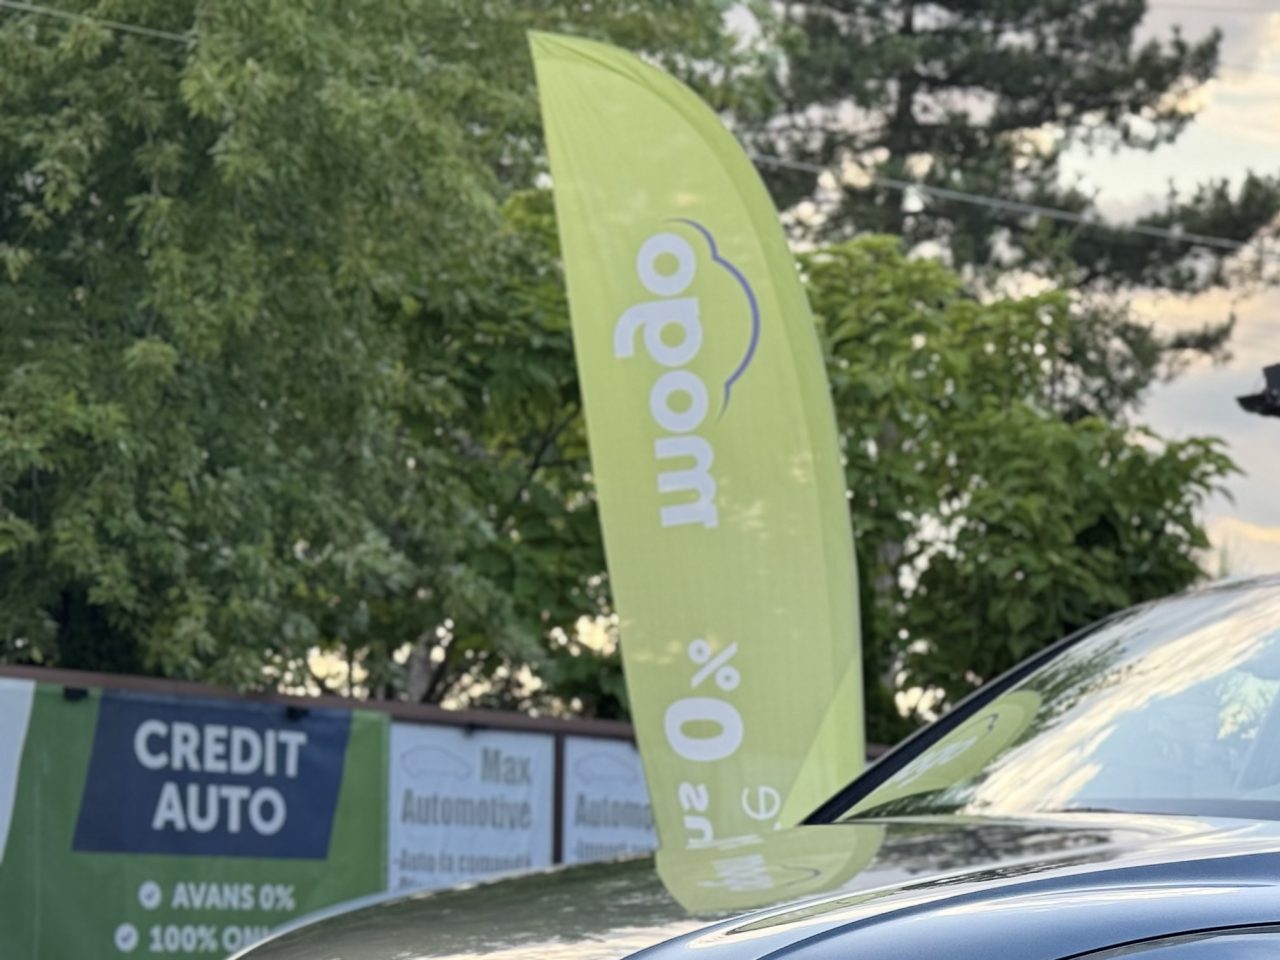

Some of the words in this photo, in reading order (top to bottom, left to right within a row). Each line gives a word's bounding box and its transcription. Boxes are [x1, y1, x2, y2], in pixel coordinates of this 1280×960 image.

[133, 719, 308, 778] CREDIT
[480, 747, 532, 785] Max
[151, 782, 287, 835] AUTO
[402, 789, 533, 830] Automotive
[171, 882, 254, 911] AVANS
[259, 884, 296, 911] 0%
[149, 924, 218, 953] 100%
